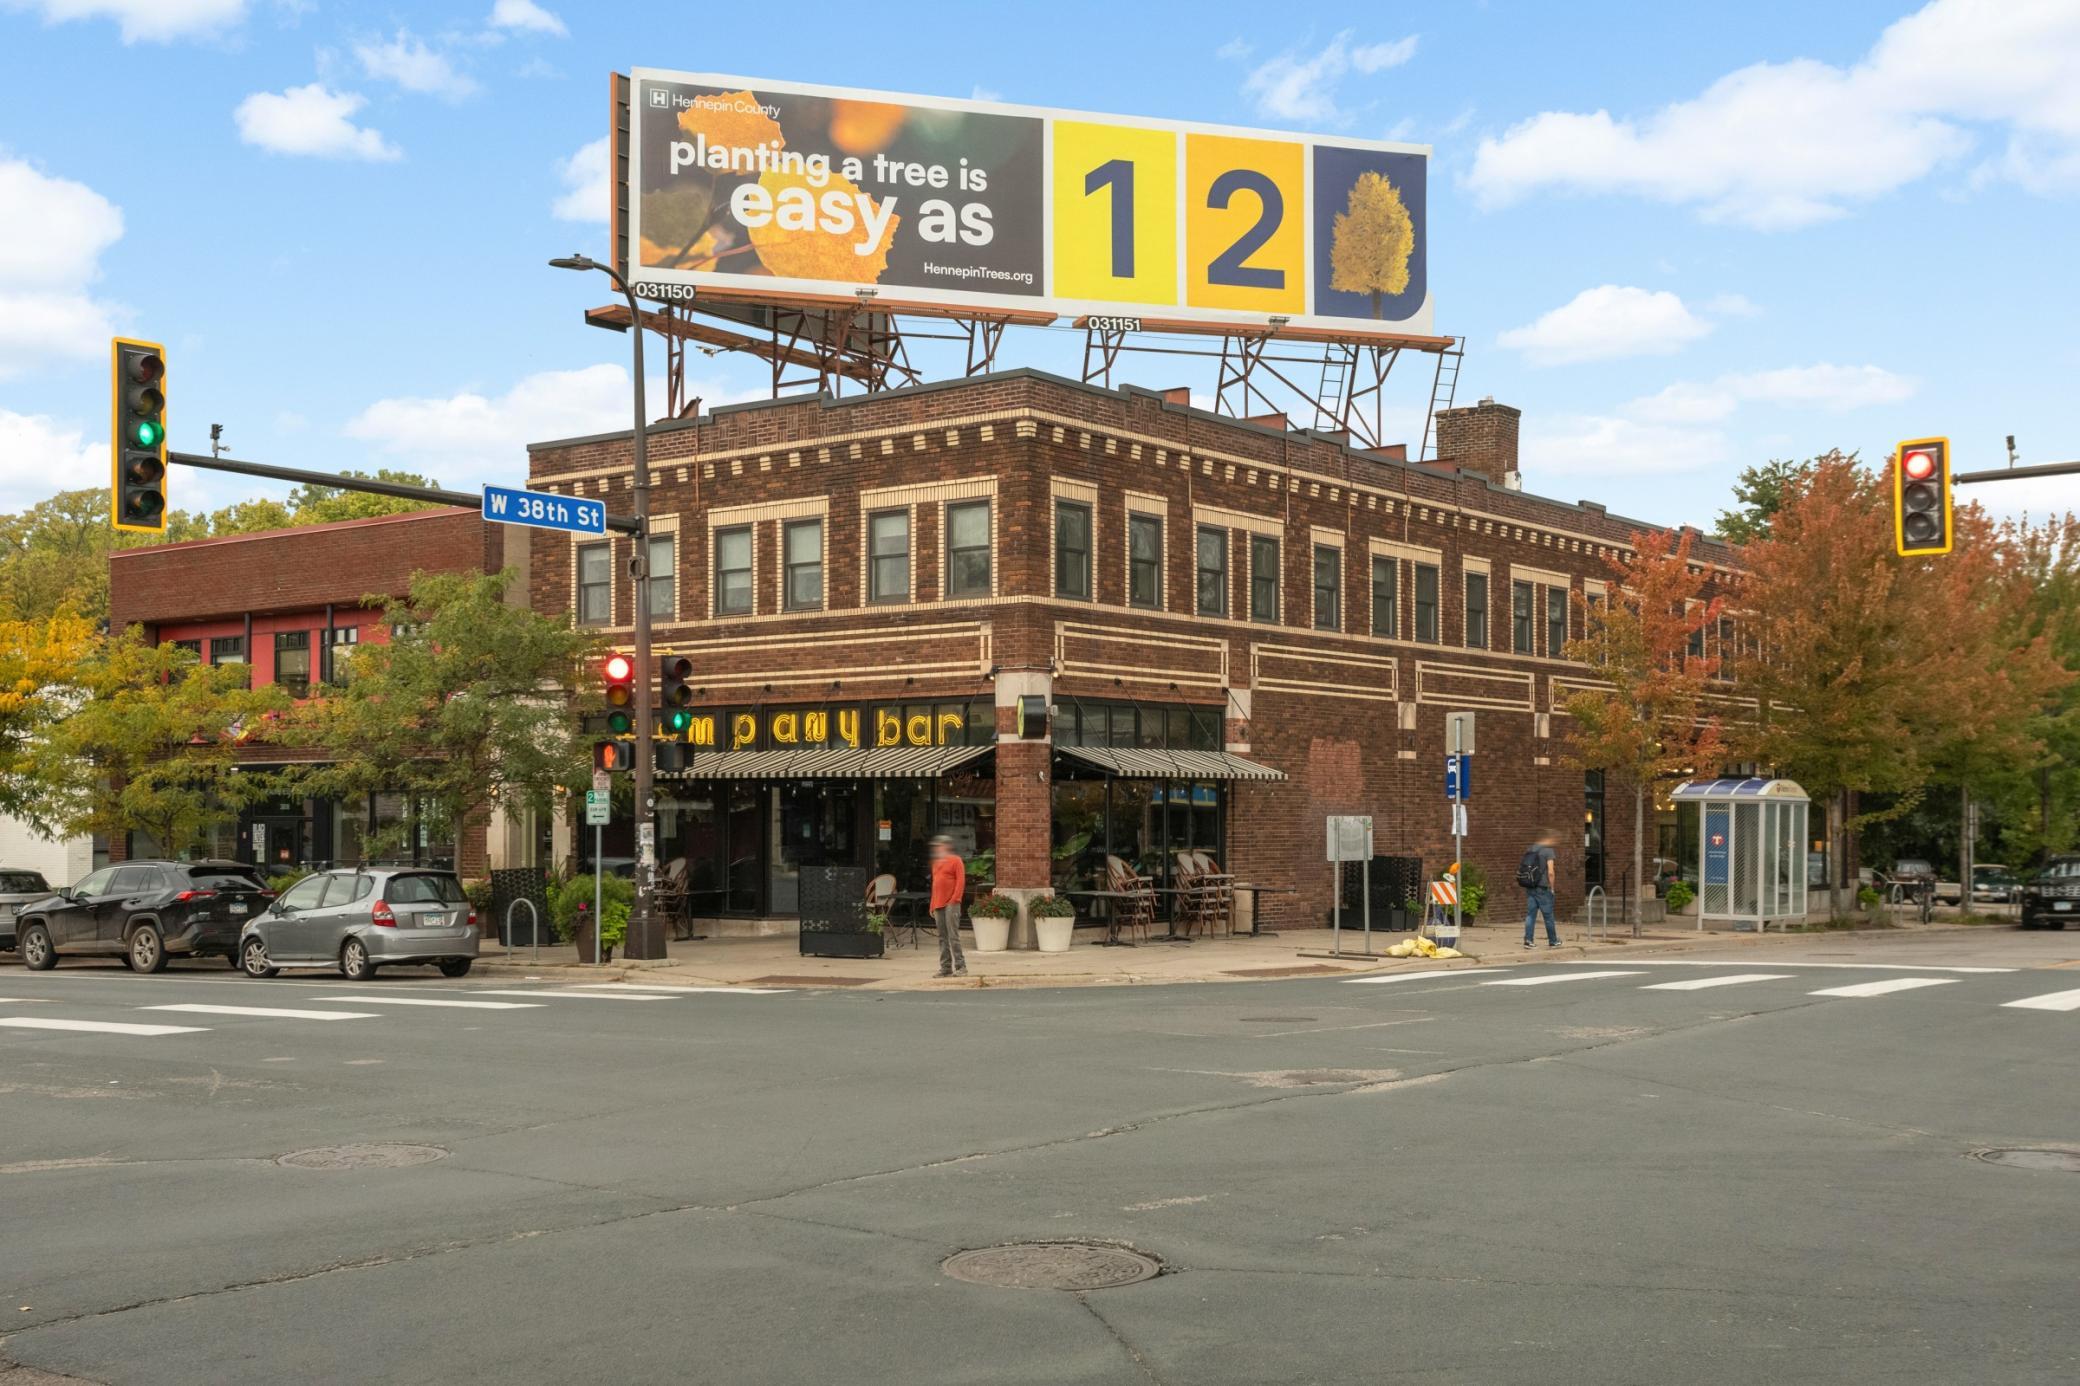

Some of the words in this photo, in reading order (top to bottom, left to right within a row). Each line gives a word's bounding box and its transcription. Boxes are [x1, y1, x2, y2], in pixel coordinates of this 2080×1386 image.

[672, 94, 733, 112] Hennepin
[734, 100, 780, 119] County
[670, 133, 830, 187] planting
[841, 156, 863, 181] a
[873, 153, 949, 190] tree
[959, 157, 988, 193] is
[730, 181, 898, 256] easy
[918, 199, 994, 247] as
[1085, 158, 1135, 279] 1
[1207, 168, 1285, 290] 2
[923, 261, 1033, 284] HennepinTrees.org
[636, 282, 694, 299] 031150
[1088, 316, 1141, 331] 031151
[491, 493, 507, 514] W
[517, 497, 569, 523] 38th
[577, 506, 599, 527] St
[877, 709, 963, 747] bar
